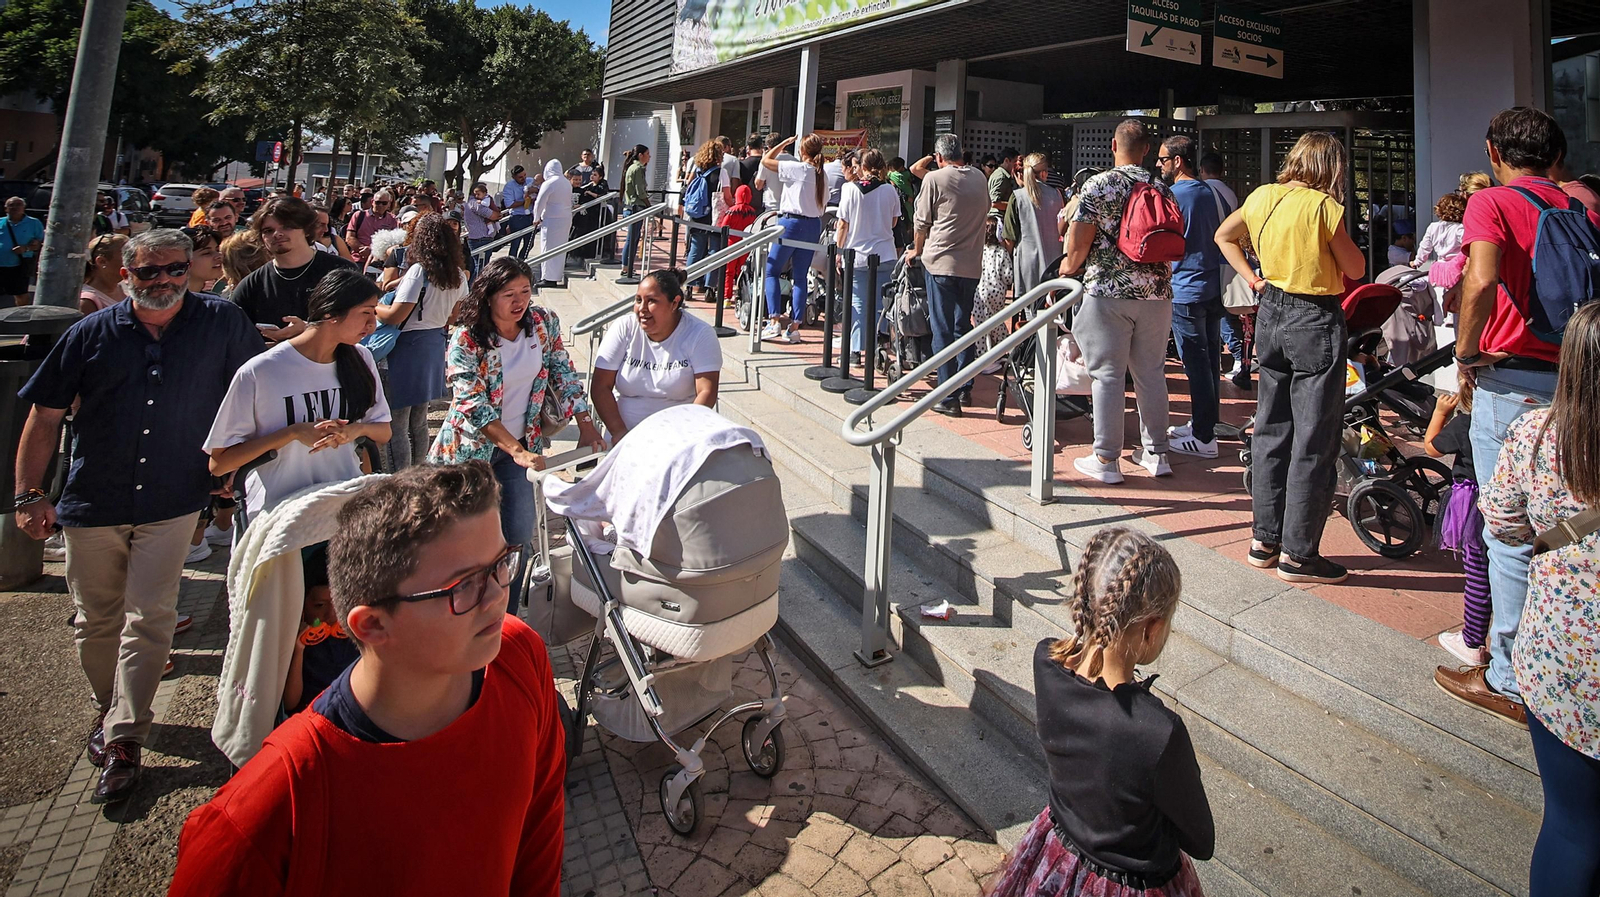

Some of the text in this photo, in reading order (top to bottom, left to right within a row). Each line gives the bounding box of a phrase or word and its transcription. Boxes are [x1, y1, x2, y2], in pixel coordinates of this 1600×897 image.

[1151, 0, 1179, 11] ACCESO
[852, 7, 860, 17] de
[1131, 4, 1200, 28] TAQUILLAS DE PAGO
[1218, 14, 1281, 35] ACCESO EXCLUSIVO
[1237, 30, 1263, 43] SOCIOS
[664, 359, 689, 371] JEANS
